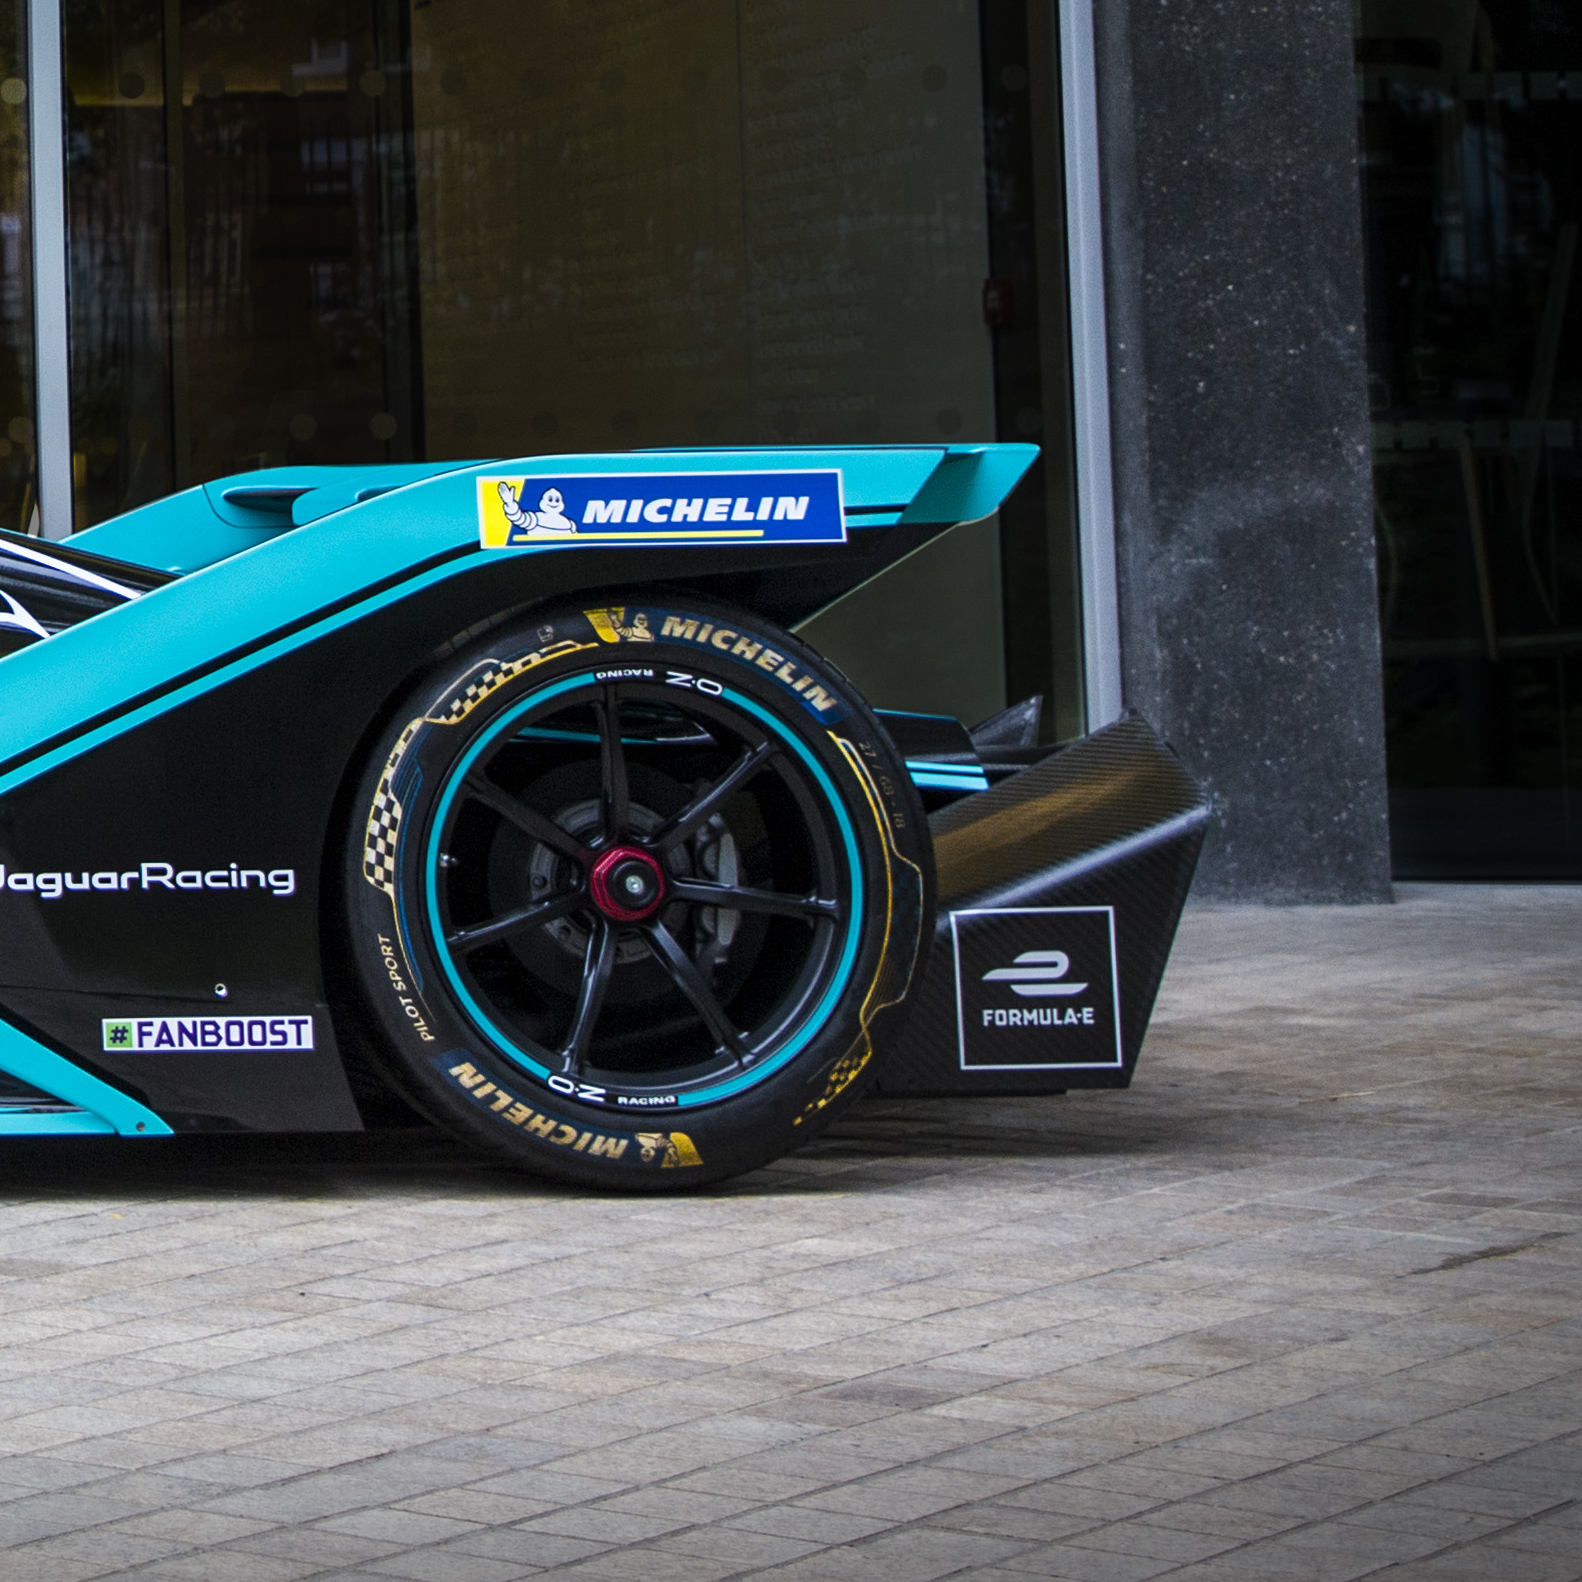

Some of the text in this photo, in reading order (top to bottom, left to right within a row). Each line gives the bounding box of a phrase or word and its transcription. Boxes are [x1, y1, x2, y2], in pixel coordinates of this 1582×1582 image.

[582, 496, 810, 524] MICHELIN
[596, 668, 654, 680] RACING
[660, 615, 838, 713] MICHELIN
[377, 933, 436, 1043] PILOT SPORT
[447, 1061, 631, 1160] MICHELIN
[617, 1094, 676, 1108] RACING
